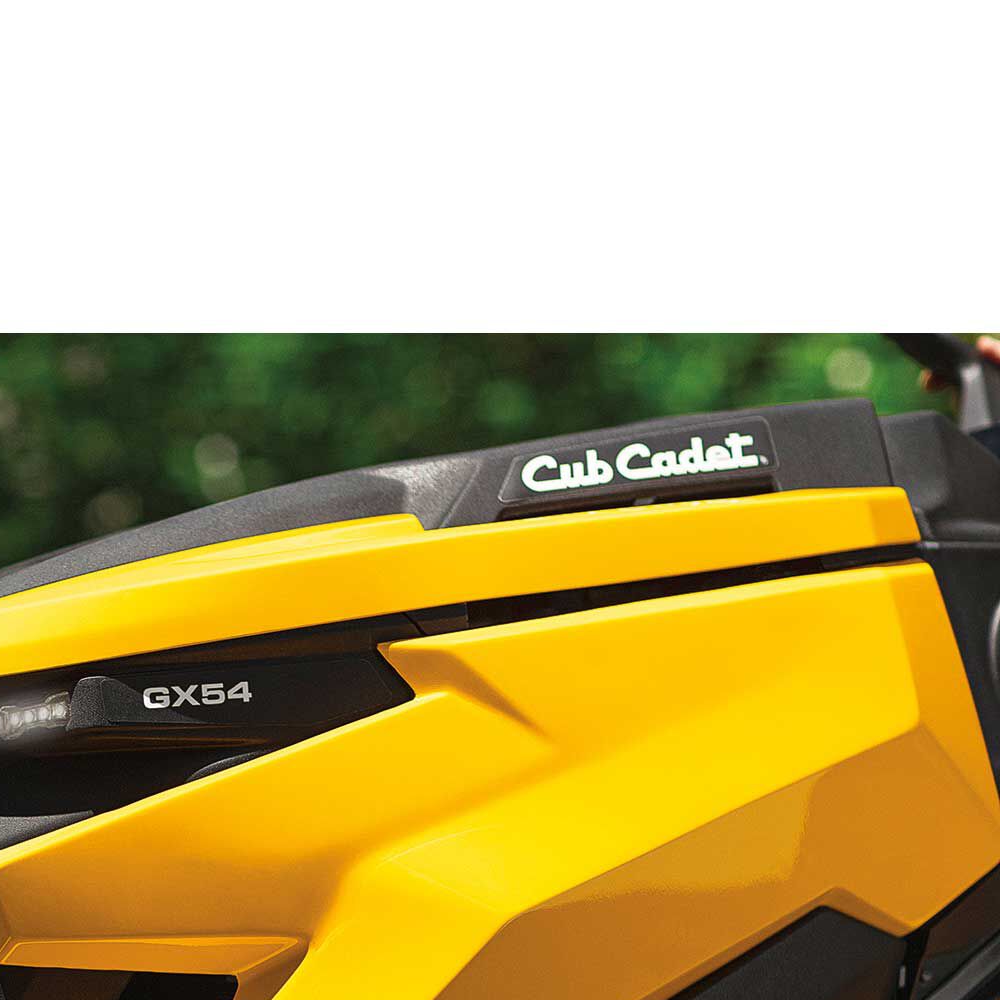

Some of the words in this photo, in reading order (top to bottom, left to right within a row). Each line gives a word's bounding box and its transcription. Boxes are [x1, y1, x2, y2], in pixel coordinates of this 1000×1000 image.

[521, 449, 614, 492] Cub
[615, 432, 759, 480] Cadet
[143, 681, 252, 709] GX54
